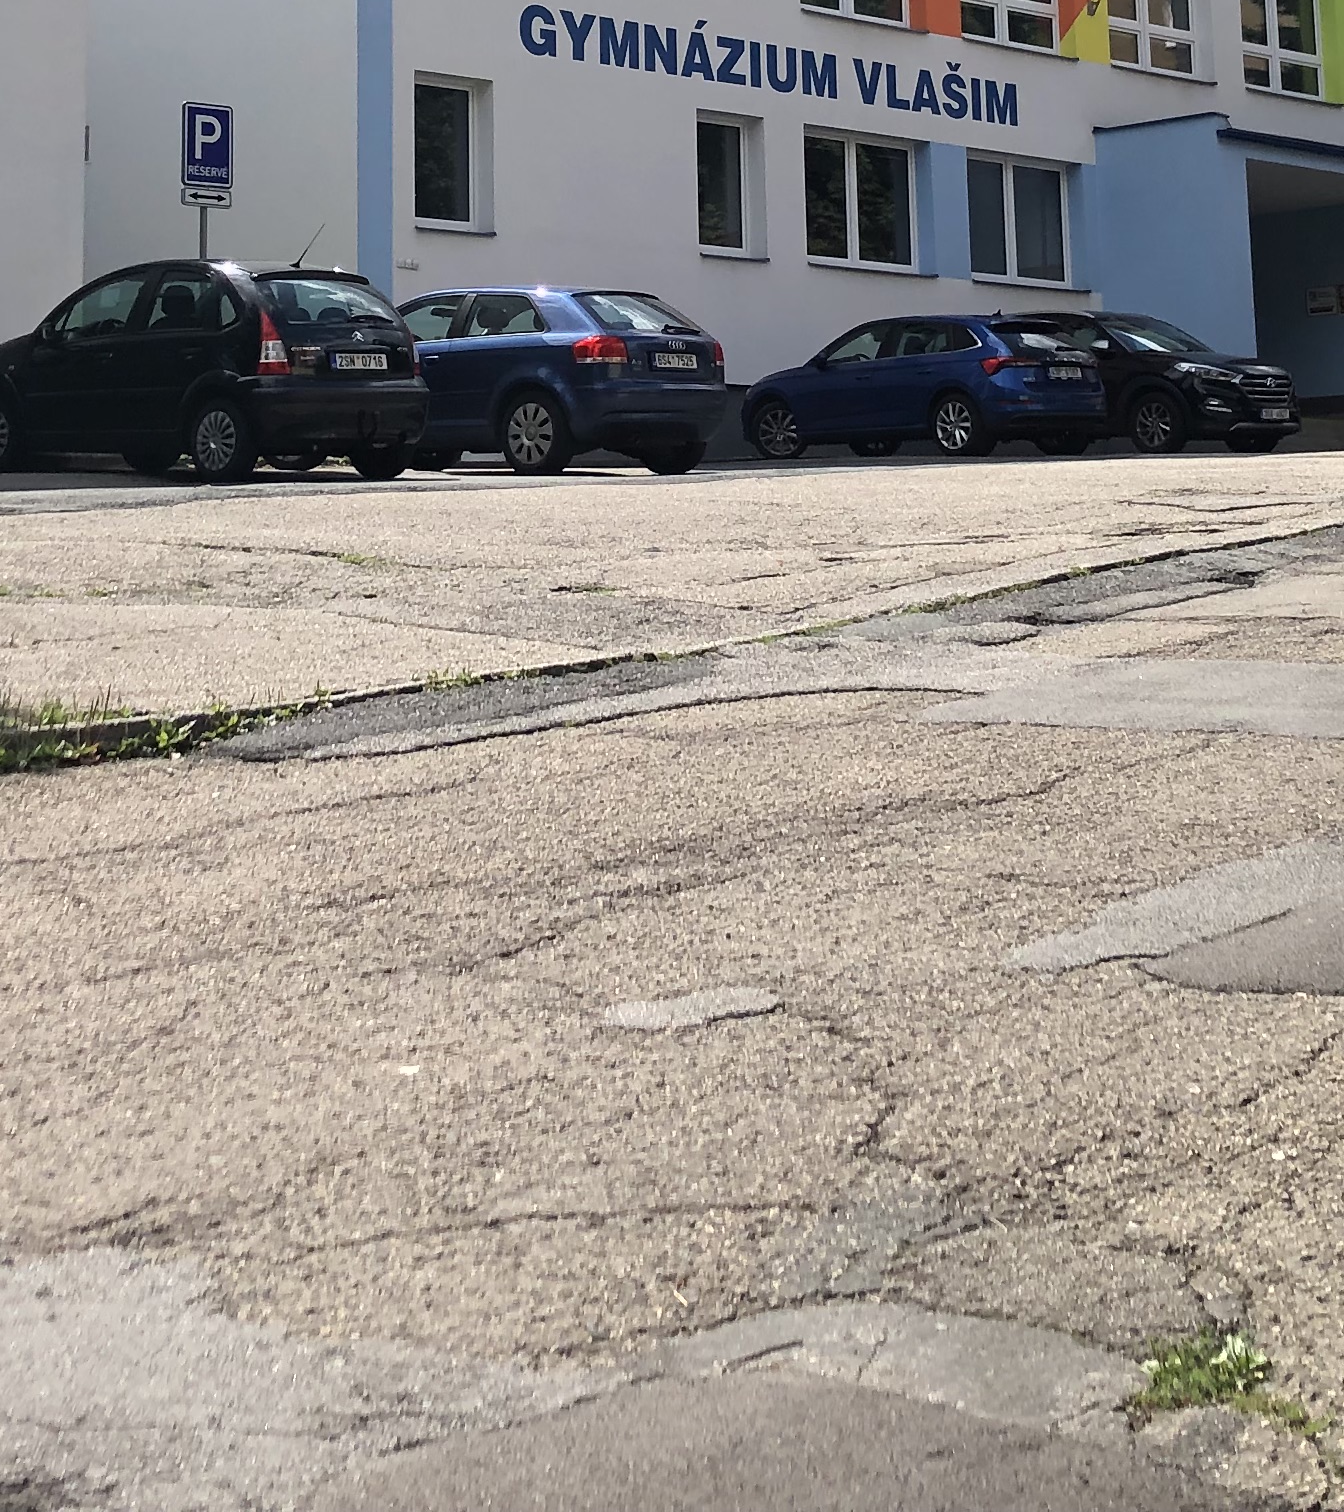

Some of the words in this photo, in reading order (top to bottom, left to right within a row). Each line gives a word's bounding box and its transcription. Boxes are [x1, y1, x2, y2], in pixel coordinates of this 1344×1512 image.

[518, 4, 838, 99] GYMNÁZIUM
[852, 58, 1019, 127] VLAŠIM
[194, 114, 222, 159] P
